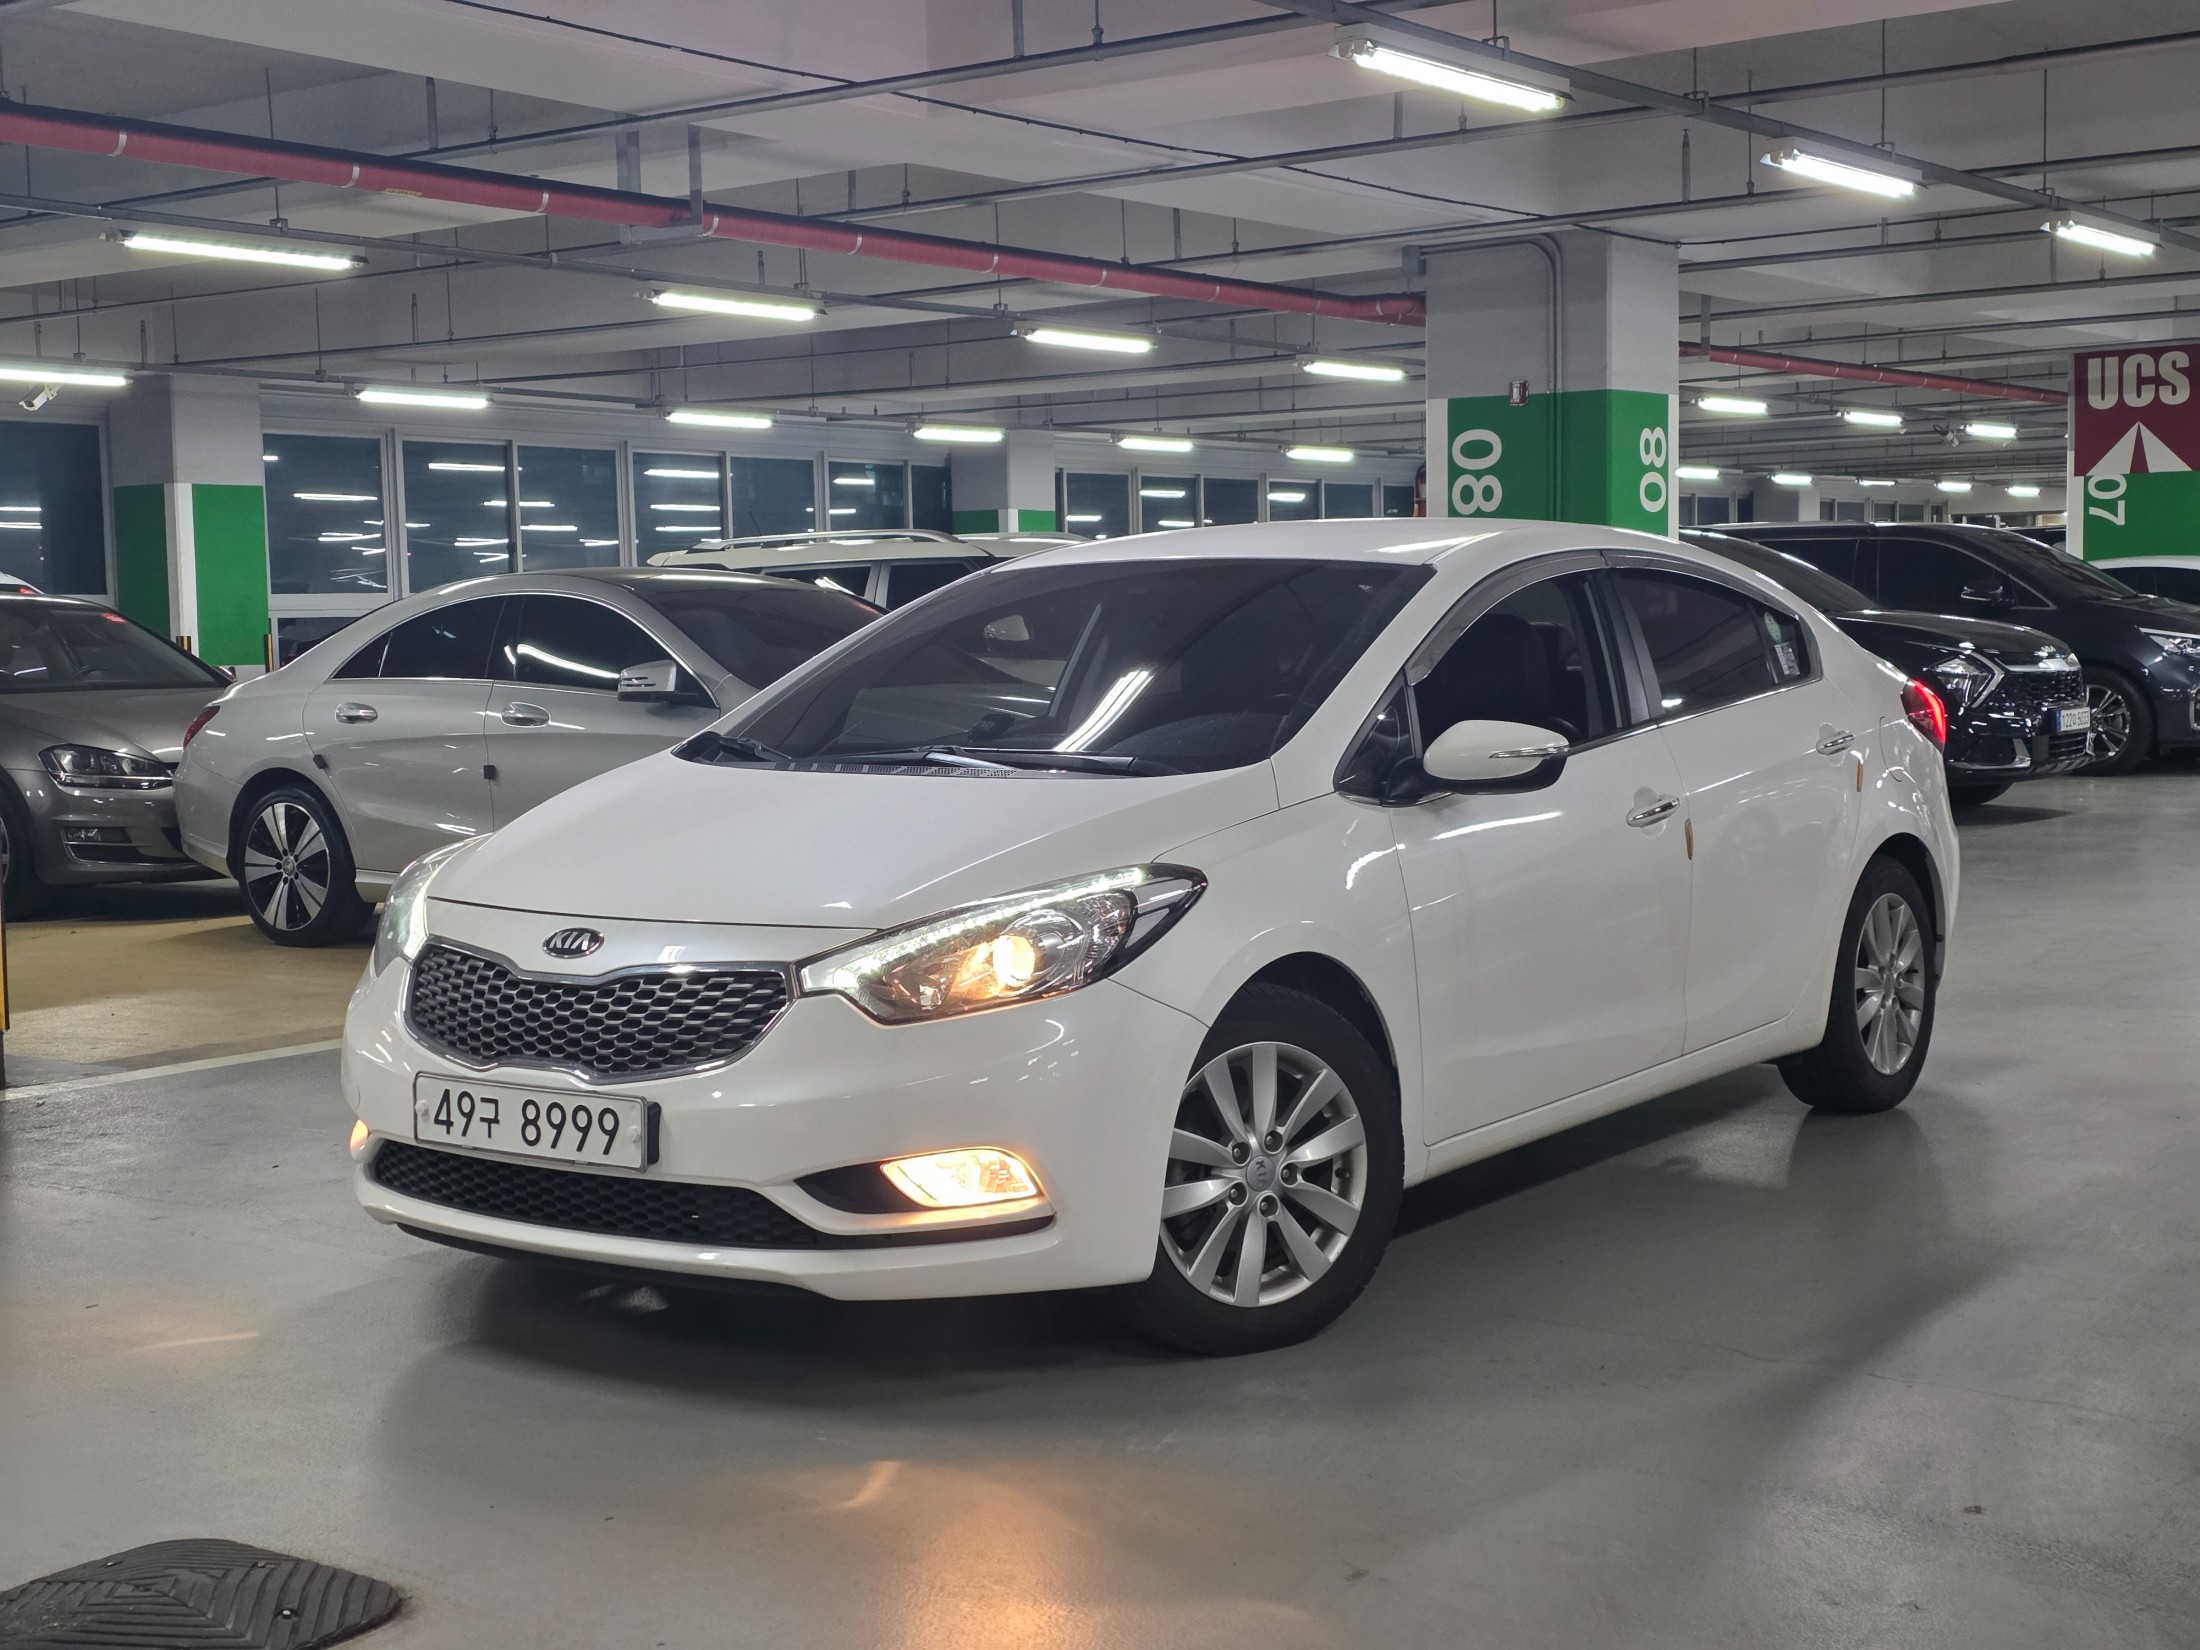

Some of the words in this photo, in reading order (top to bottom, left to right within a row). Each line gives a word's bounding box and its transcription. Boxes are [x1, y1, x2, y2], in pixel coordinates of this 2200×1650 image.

[2087, 351, 2190, 410] UCS
[1451, 428, 1503, 515] 08
[2088, 473, 2127, 526] 07
[548, 931, 592, 951] KIA
[433, 1088, 500, 1139] 49구
[520, 1098, 620, 1156] 8999
